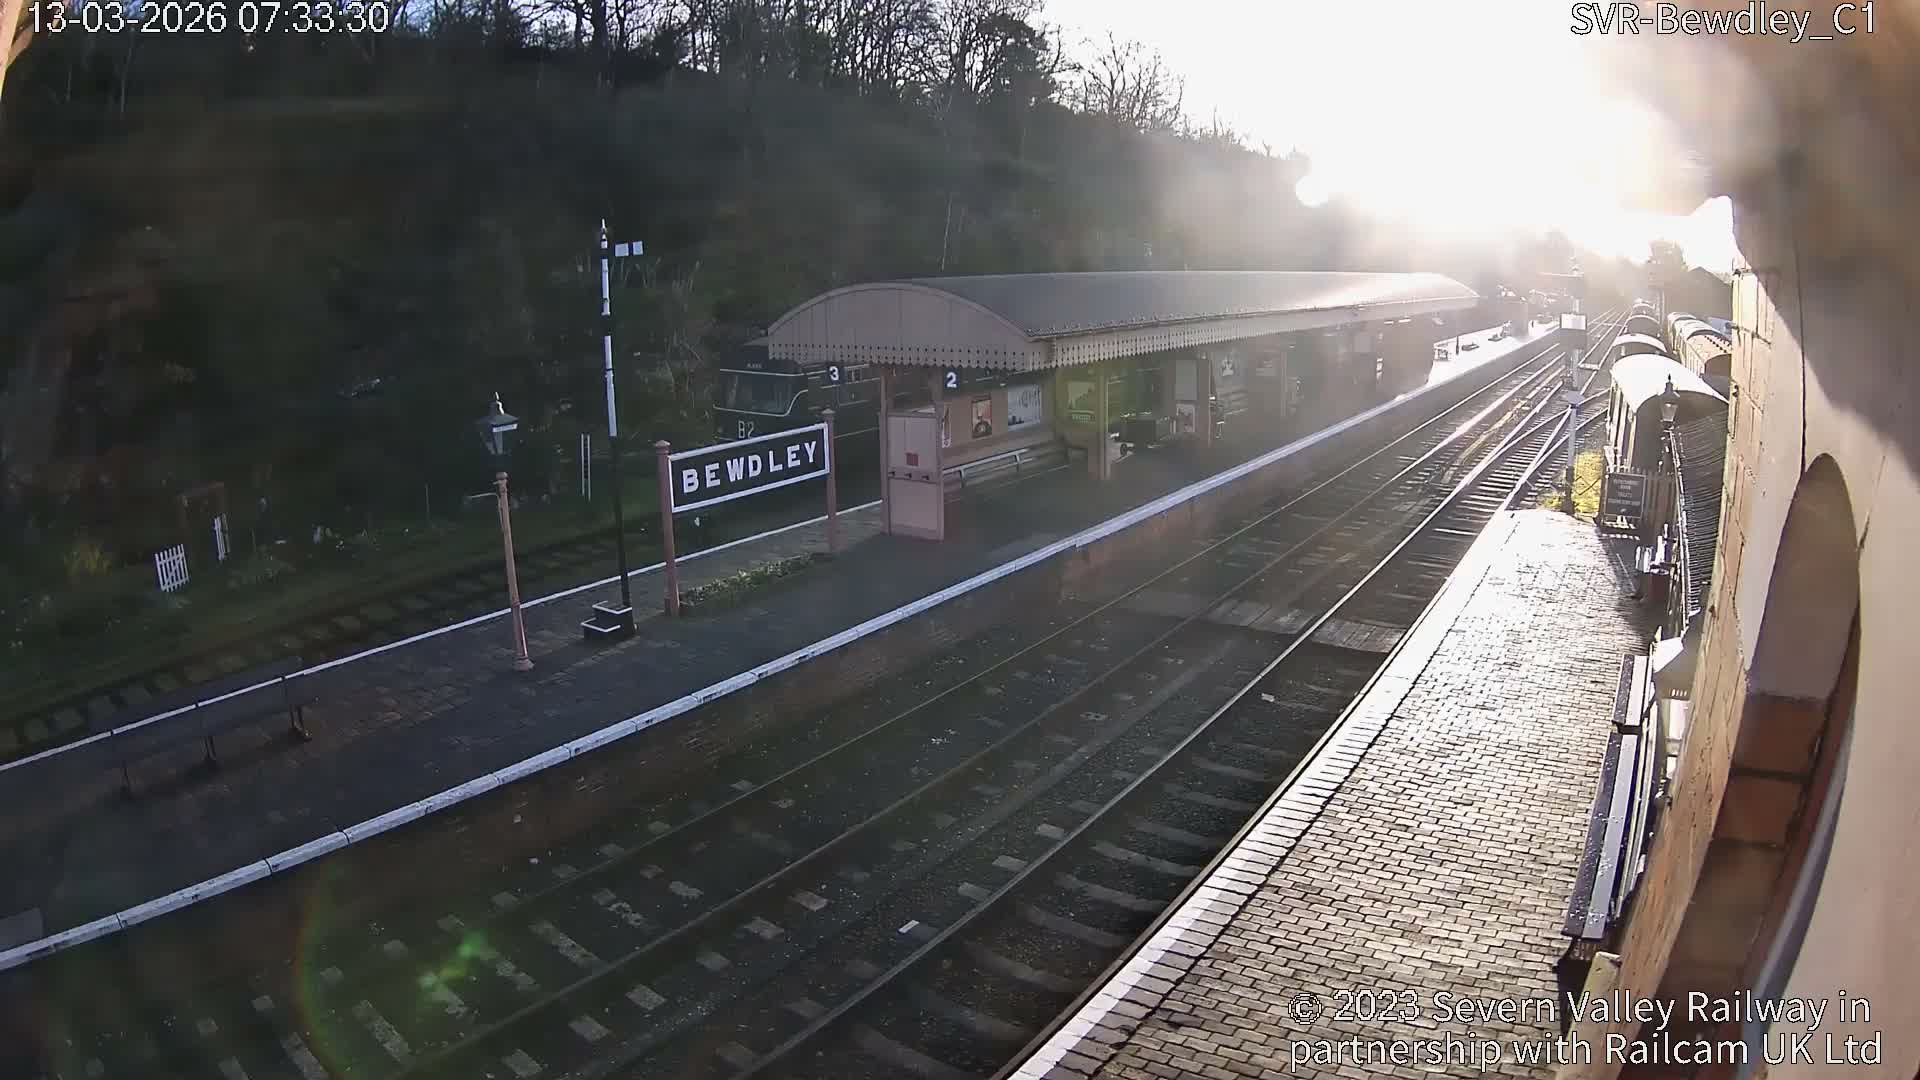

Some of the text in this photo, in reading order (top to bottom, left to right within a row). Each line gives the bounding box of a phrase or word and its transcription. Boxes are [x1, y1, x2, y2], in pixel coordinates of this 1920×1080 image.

[829, 366, 840, 382] 3
[945, 371, 958, 389] 2
[681, 440, 818, 495] BEWDLEY
